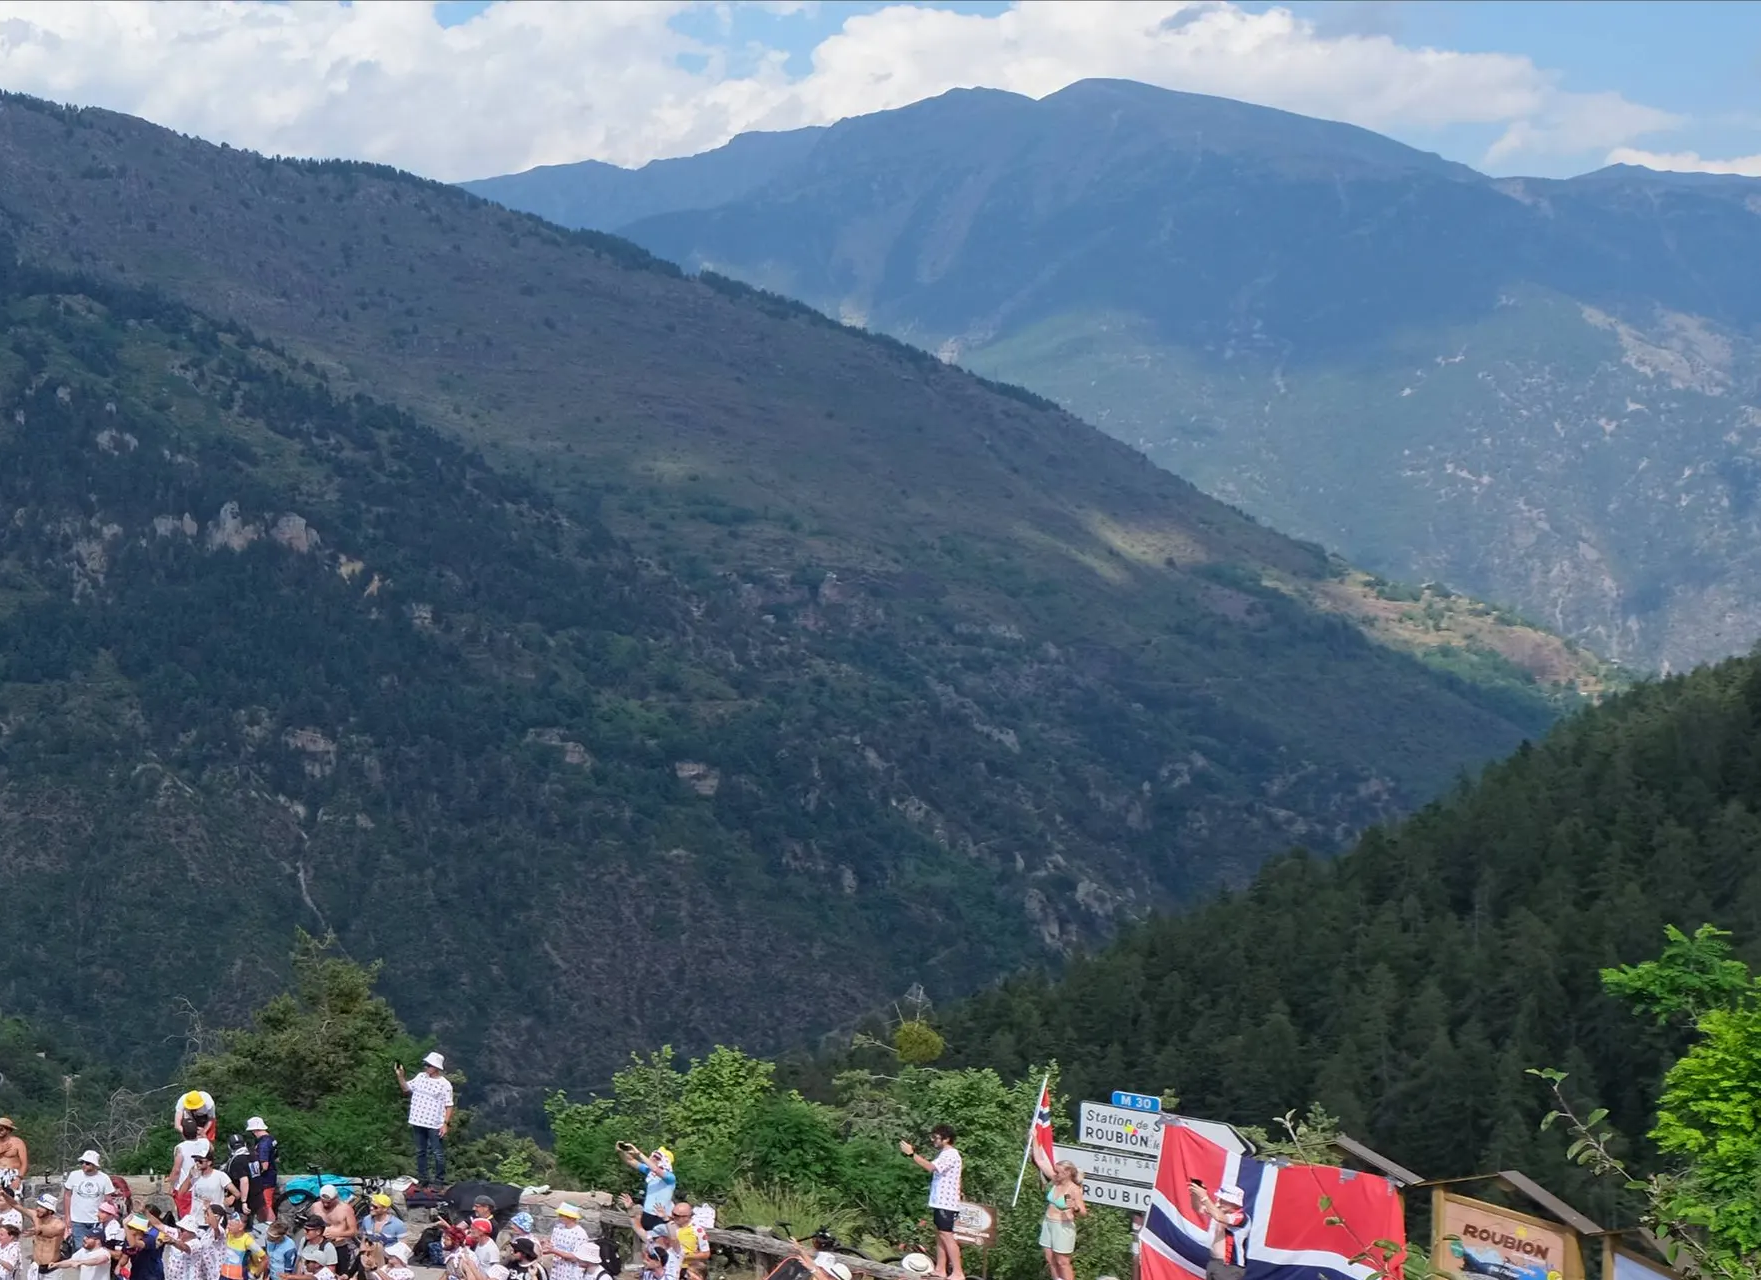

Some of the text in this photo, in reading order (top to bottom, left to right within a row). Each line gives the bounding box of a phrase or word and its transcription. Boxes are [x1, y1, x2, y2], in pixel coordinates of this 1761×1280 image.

[1120, 1094, 1152, 1109] M 30
[1086, 1109, 1161, 1133] Station de S
[1085, 1126, 1150, 1148] ROUBION
[1092, 1165, 1120, 1177] NICE
[1094, 1153, 1129, 1167] SAINT
[1082, 1184, 1152, 1207] ROUBIO
[1462, 1223, 1550, 1260] ROUBION
